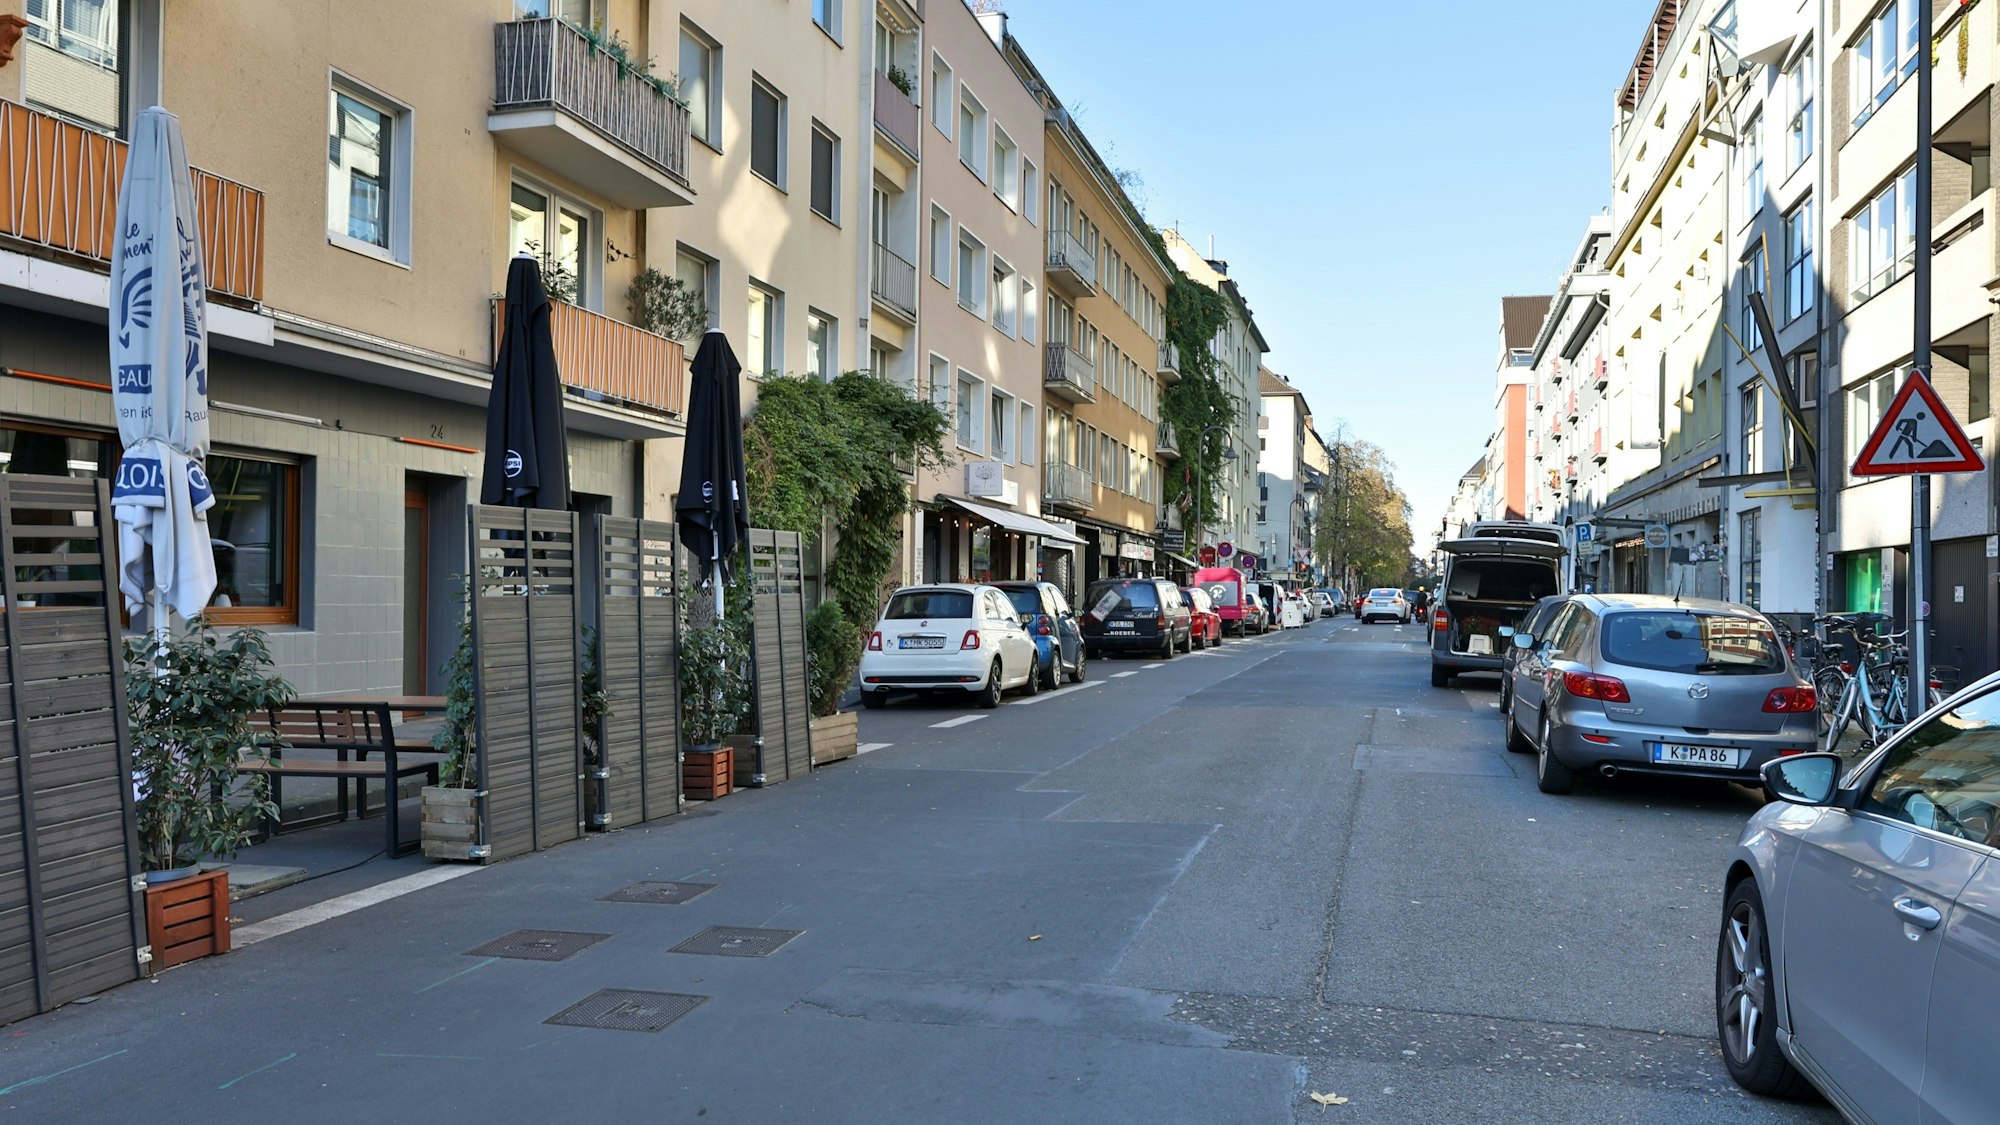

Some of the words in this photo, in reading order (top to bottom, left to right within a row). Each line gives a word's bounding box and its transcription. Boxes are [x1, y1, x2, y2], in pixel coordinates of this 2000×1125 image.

[119, 369, 152, 388] GAU
[431, 424, 443, 439] 24
[117, 463, 165, 490] LOI
[1579, 526, 1588, 541] P
[1671, 746, 1680, 759] K
[1689, 748, 1707, 761] PA
[1710, 749, 1727, 762] 86
